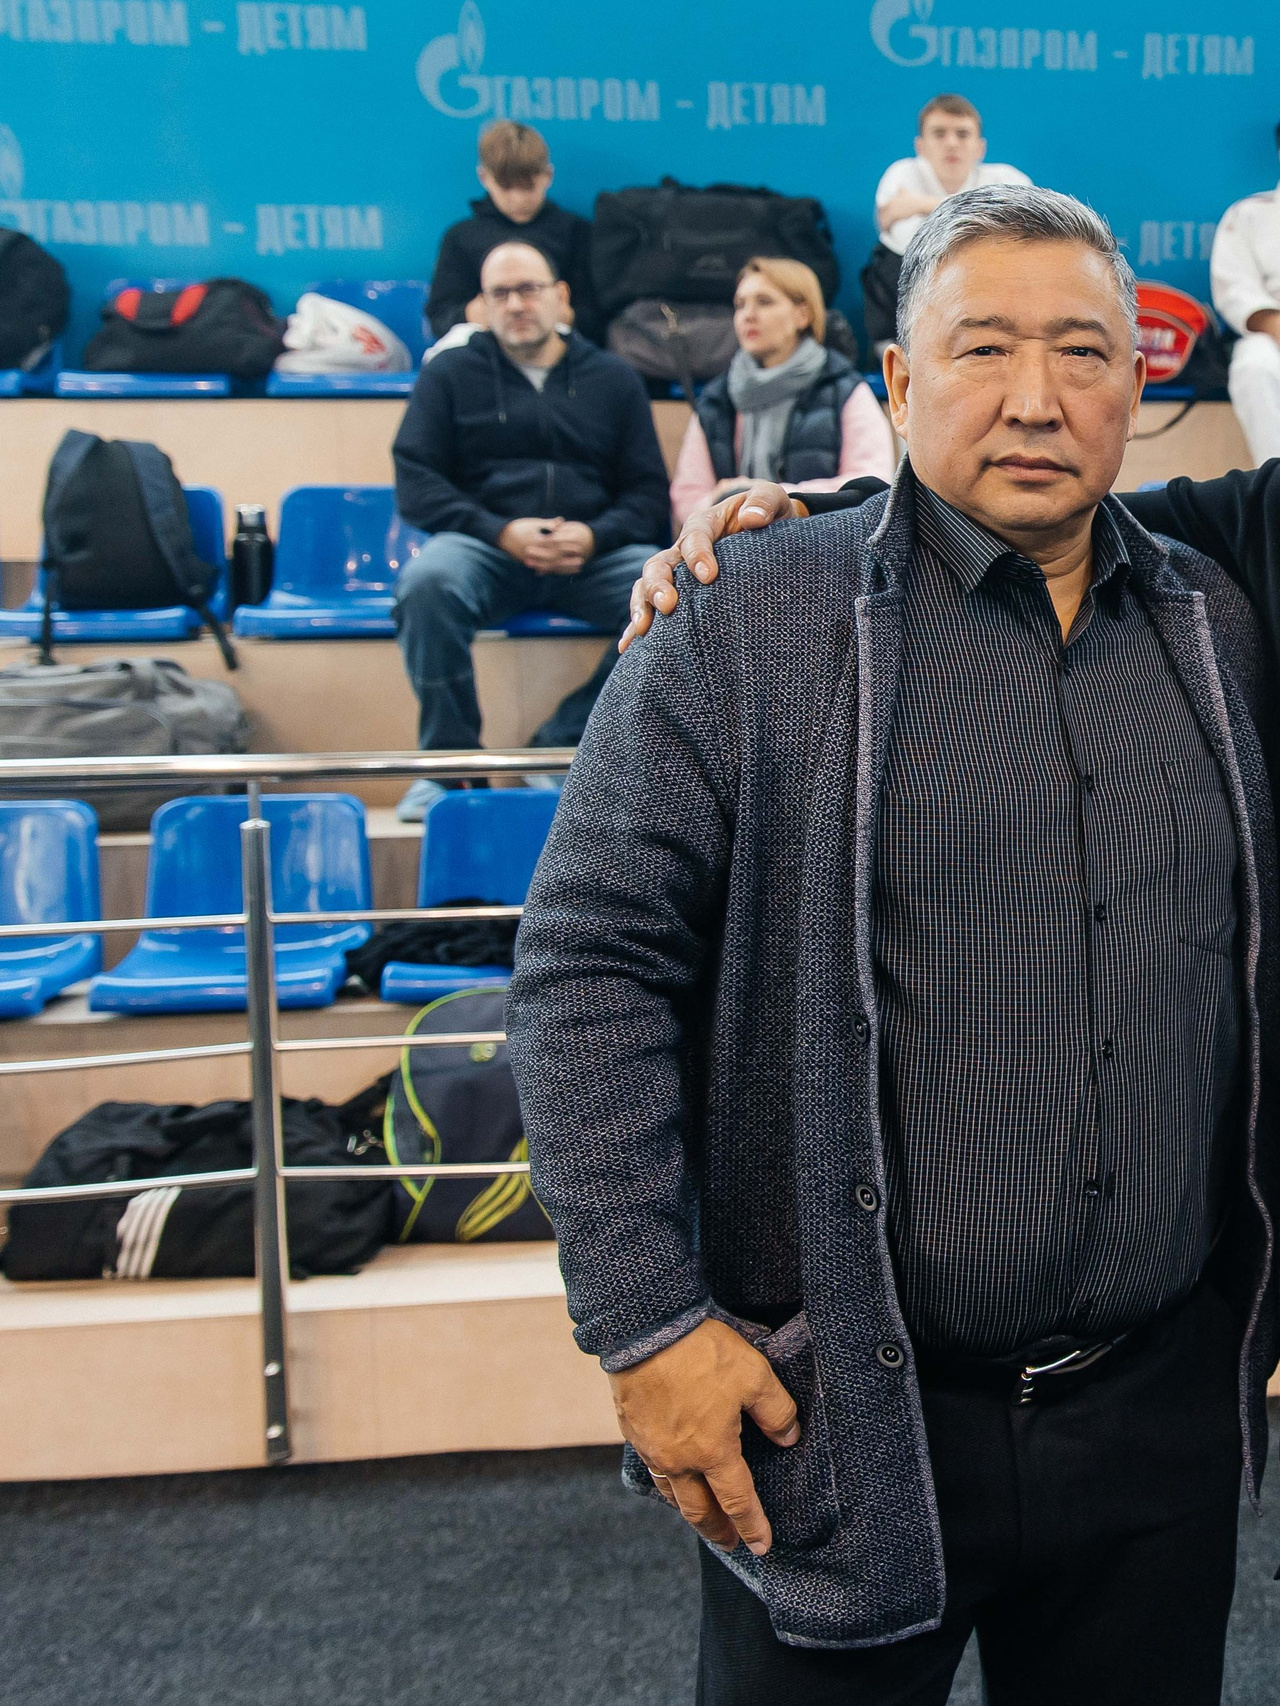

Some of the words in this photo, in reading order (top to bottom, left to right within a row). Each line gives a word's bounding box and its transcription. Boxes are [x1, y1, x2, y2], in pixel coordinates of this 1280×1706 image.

[9, 0, 190, 46] ГАЗПРОМ
[237, 3, 368, 55] ДЕТЯМ
[942, 27, 1098, 71] ГАЗПРОМ
[1142, 32, 1255, 81] ДЕТЯМ
[493, 75, 661, 122] ГАЗПРОМ
[706, 81, 827, 130] ДЕТЯМ
[34, 200, 210, 247] ГАЗПРОМ
[256, 203, 384, 256] ДЕТЯМ
[1137, 219, 1216, 267] ДЕТЯ
